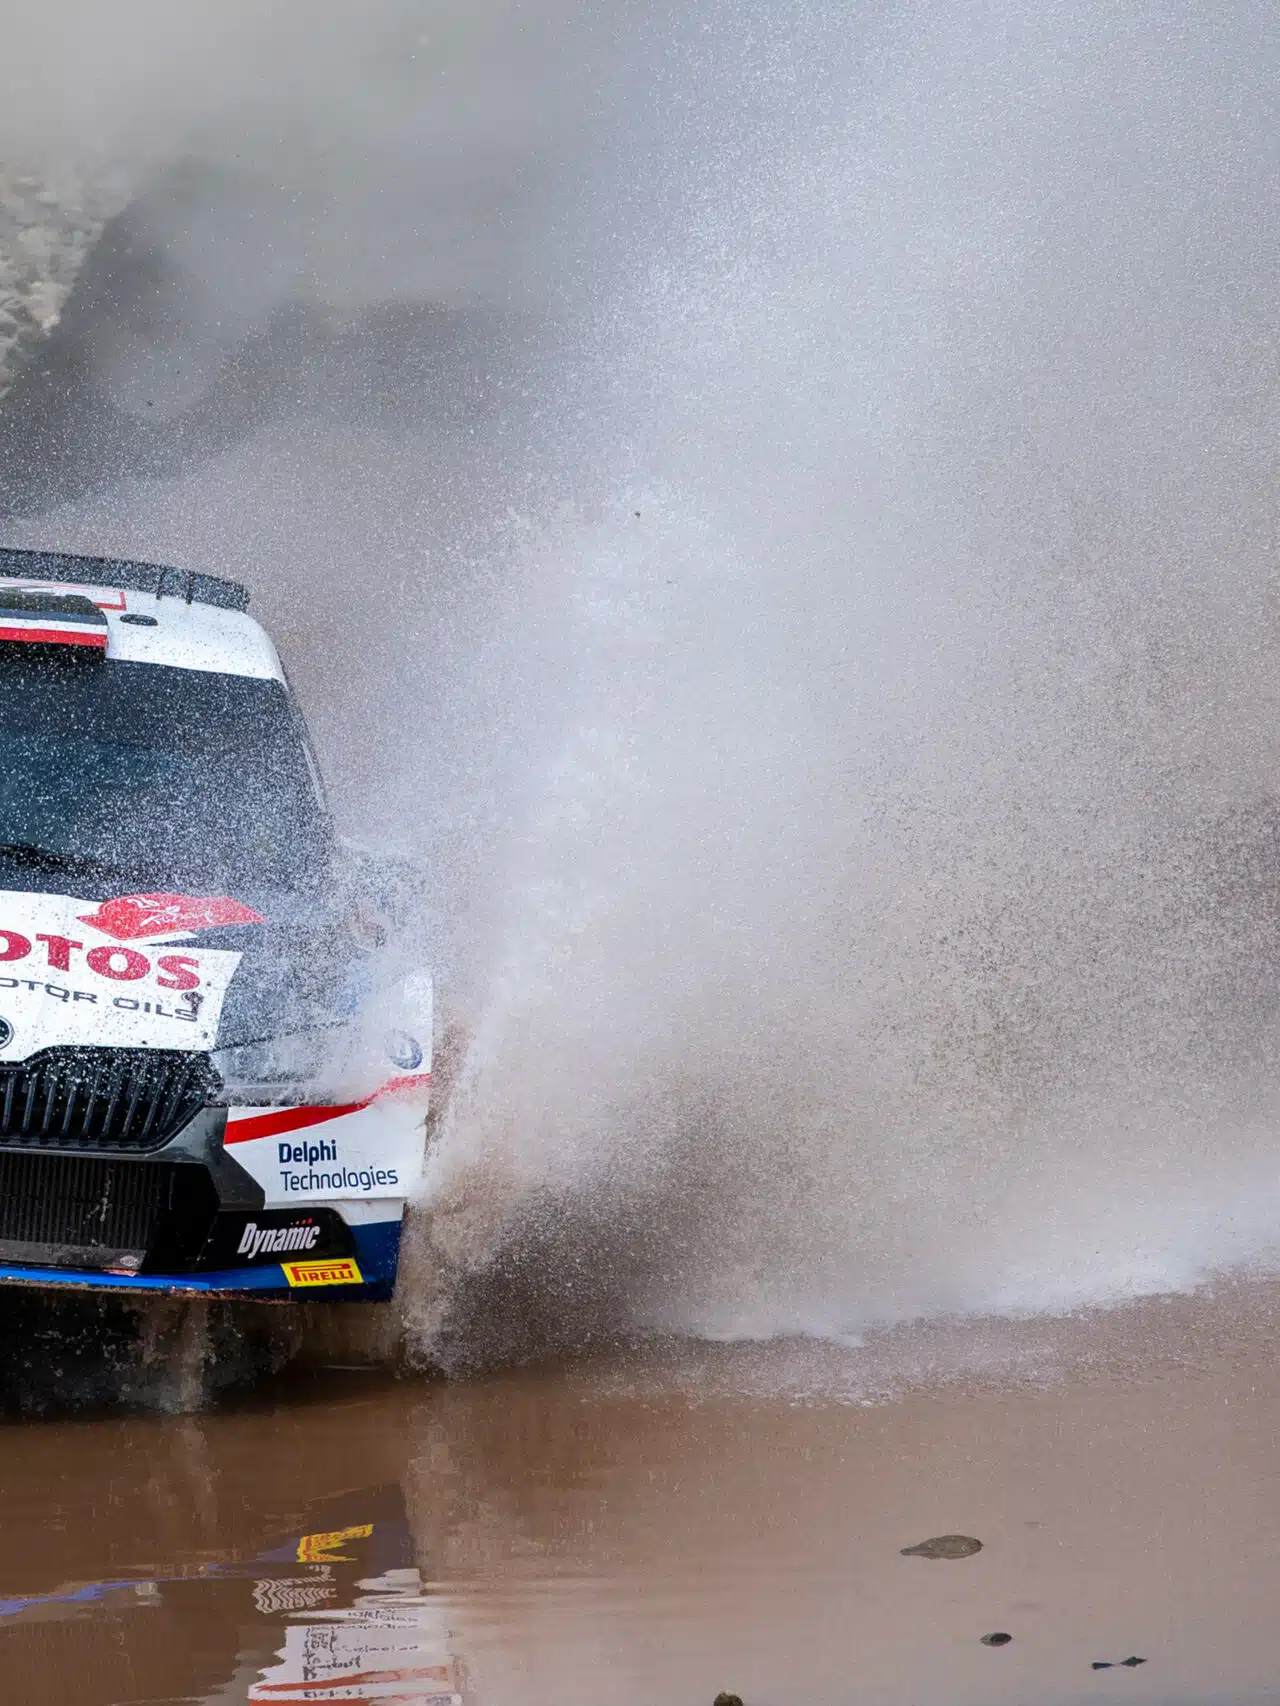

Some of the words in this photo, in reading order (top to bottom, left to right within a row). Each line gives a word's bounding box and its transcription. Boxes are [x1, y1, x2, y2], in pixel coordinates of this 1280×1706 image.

[112, 996, 199, 1023] OILS
[278, 1139, 337, 1166] Delphi
[279, 1166, 399, 1191] Technologies
[237, 1221, 320, 1259] Dynamic
[289, 1262, 354, 1282] PIRELLI
